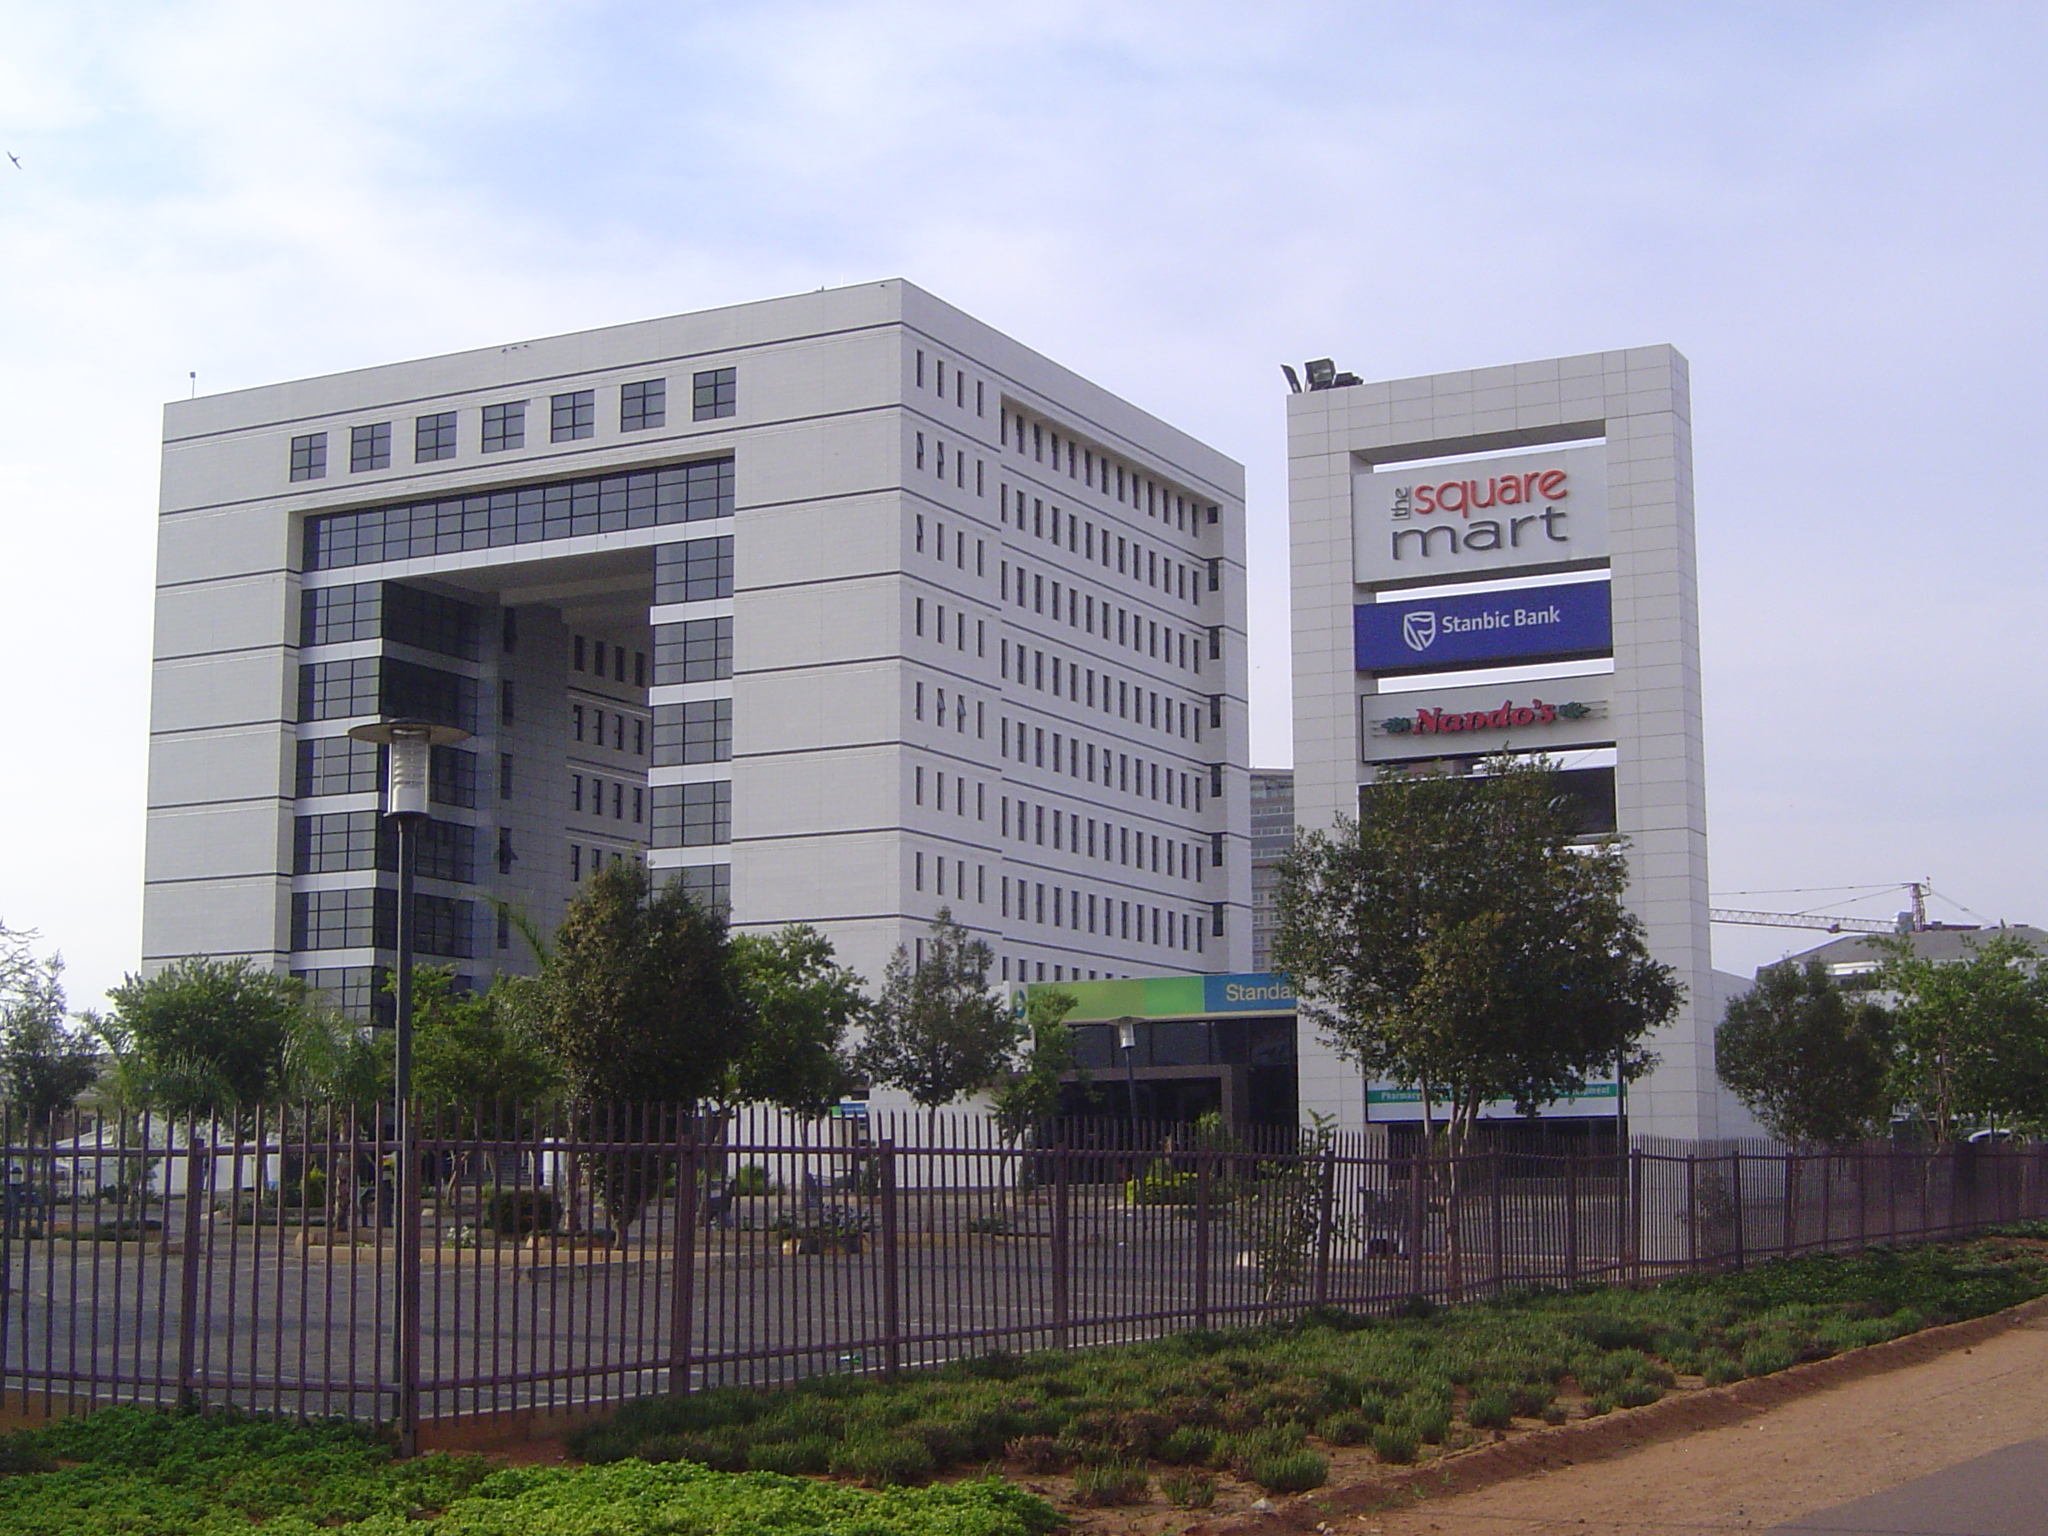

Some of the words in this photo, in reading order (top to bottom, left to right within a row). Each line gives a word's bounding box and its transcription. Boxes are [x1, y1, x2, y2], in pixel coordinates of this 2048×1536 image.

[1391, 487, 1409, 519] the
[1414, 470, 1567, 518] square
[1392, 506, 1568, 560] mart
[1442, 610, 1510, 634] Stanbic
[1514, 605, 1561, 627] Bank
[1413, 699, 1556, 735] Nando's
[1226, 982, 1296, 1002] Standa
